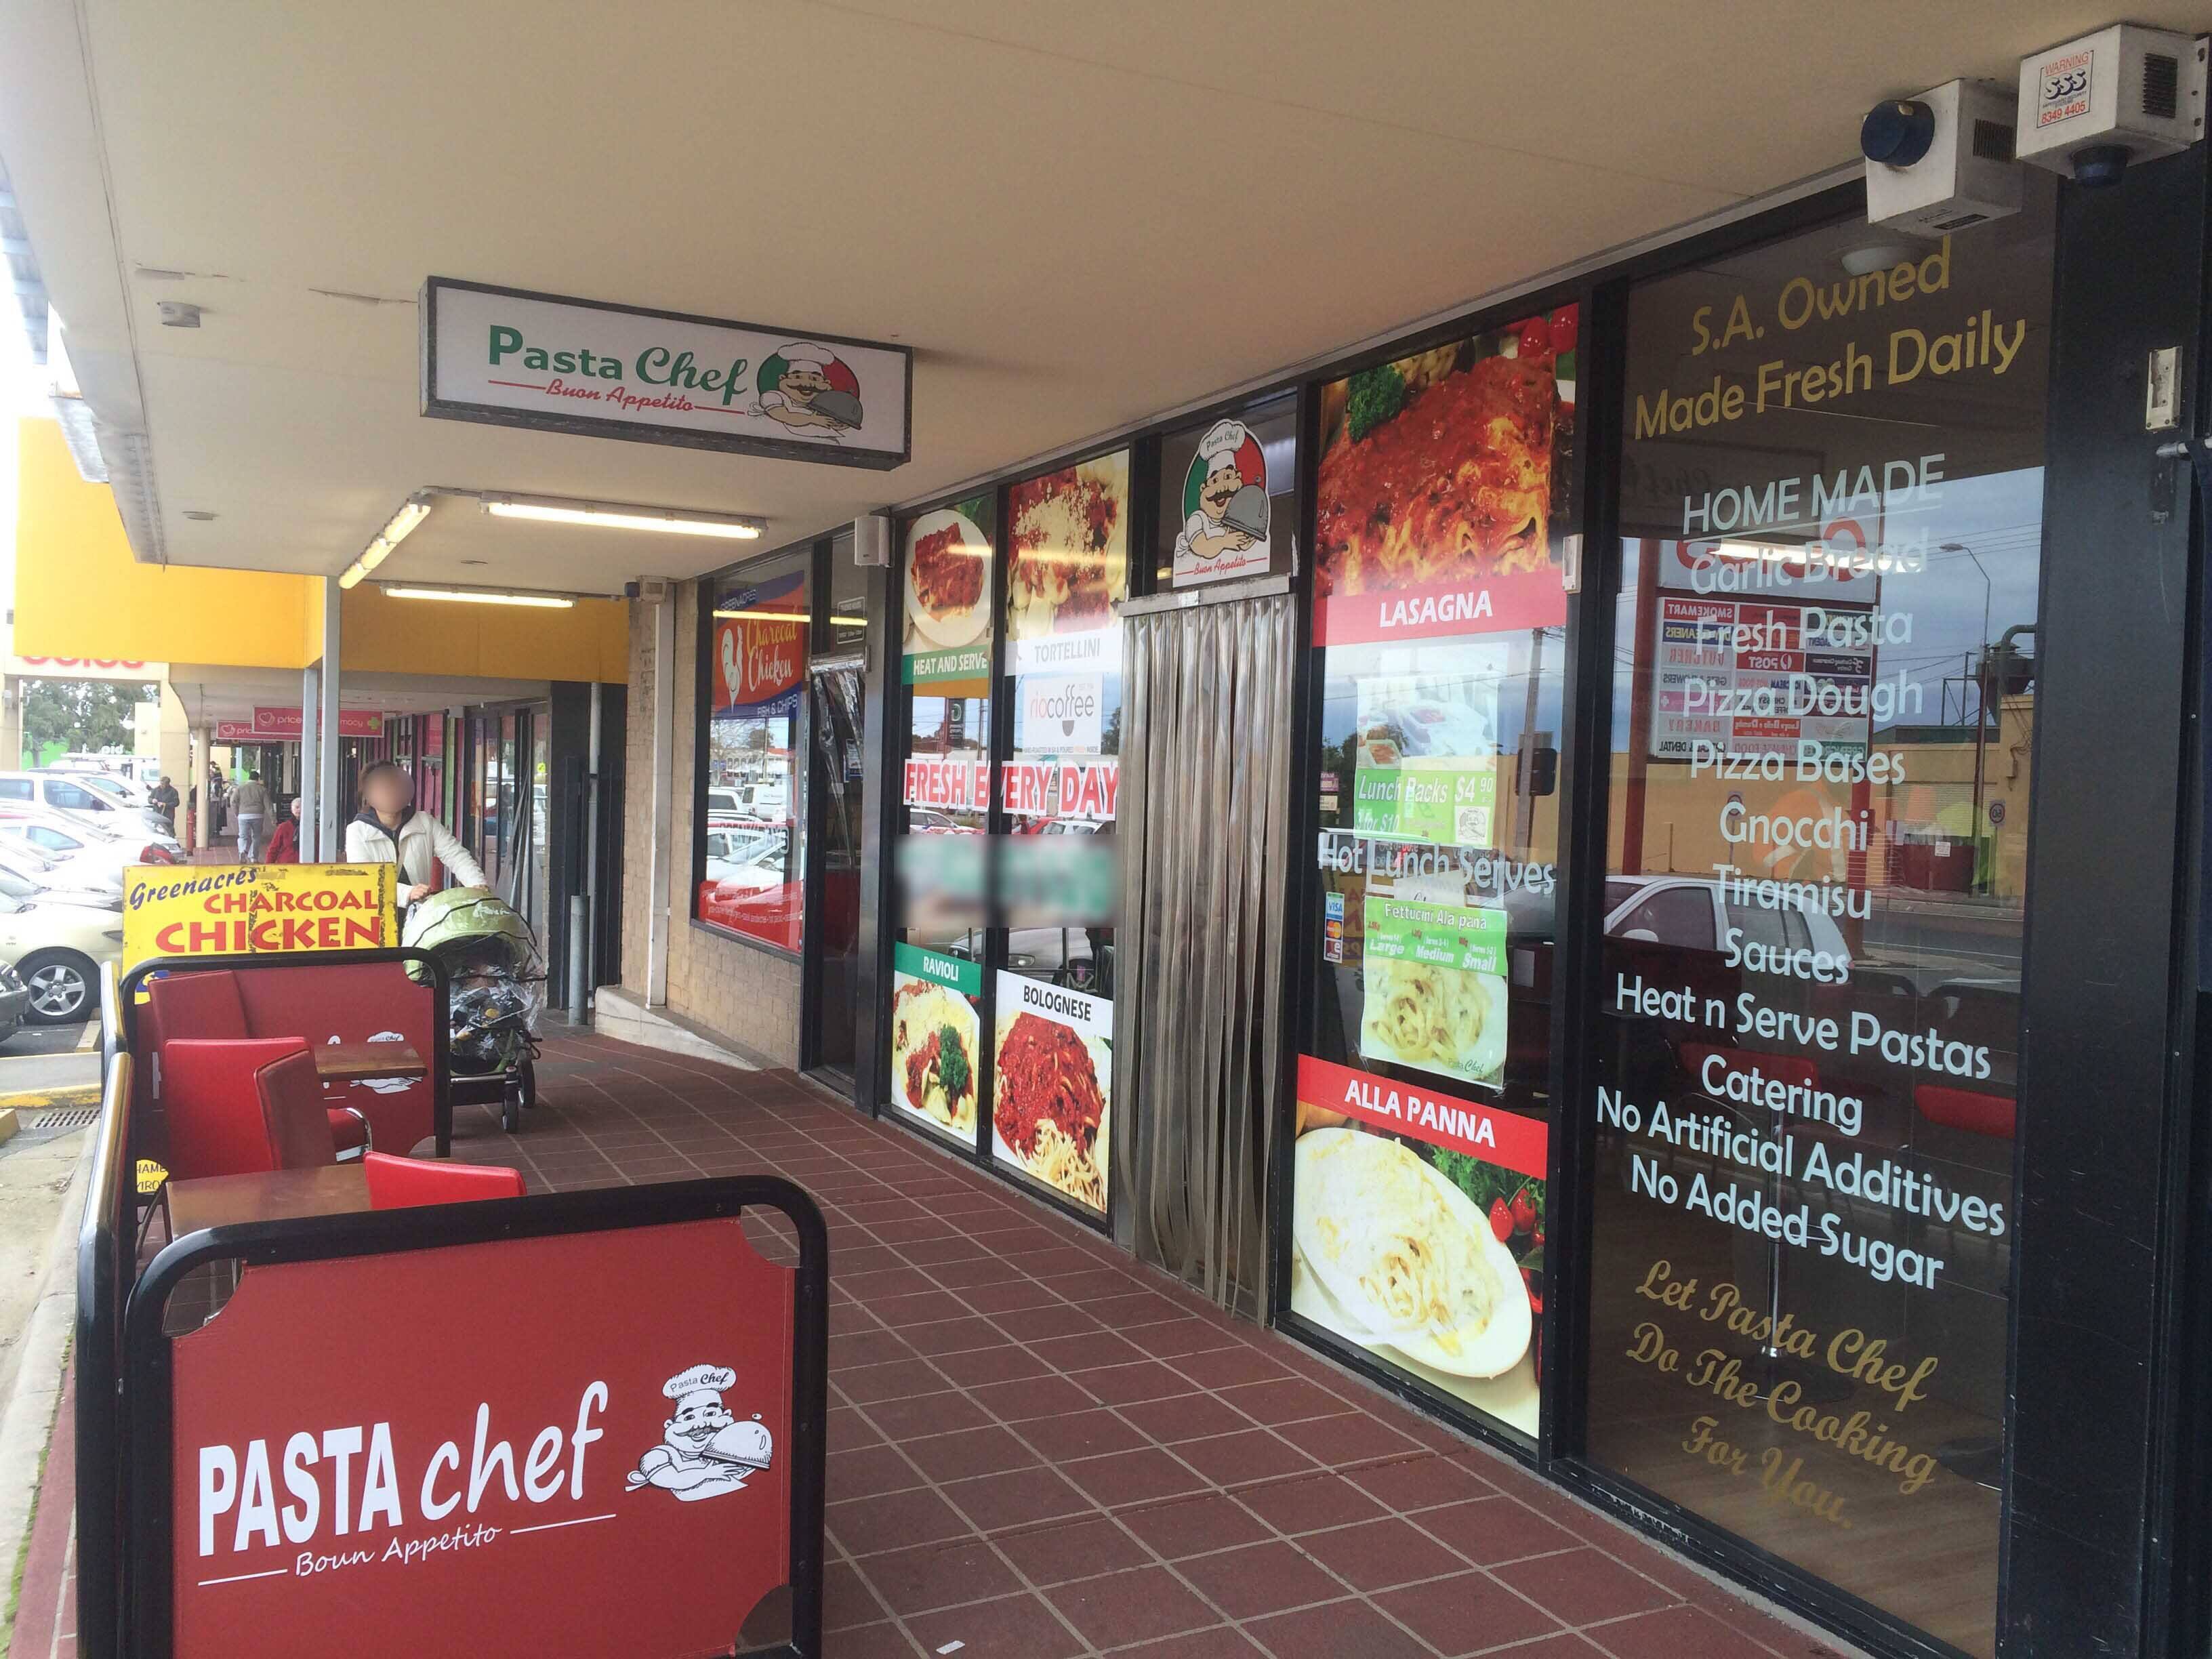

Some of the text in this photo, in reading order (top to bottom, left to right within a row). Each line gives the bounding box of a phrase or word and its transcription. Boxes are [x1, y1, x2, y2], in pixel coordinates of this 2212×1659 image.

[2043, 68, 2087, 100] SSS
[2045, 52, 2089, 75] WARNING
[2041, 108, 2062, 124] 8349
[2064, 100, 2086, 117] 4405
[1692, 234, 1952, 356] S.A. Owned
[488, 325, 749, 406] Pasta Chef
[1635, 309, 2026, 441] Made Fresh Daily
[546, 377, 694, 412] Buon Appetito
[1206, 430, 1239, 452] Pasta Chef
[1683, 453, 1946, 535] HOME MADE
[1193, 556, 1247, 575] Buon Appetito
[1691, 544, 1793, 595] Garlic
[1803, 527, 1929, 583] Bread
[1380, 590, 1493, 628] LASAGNA
[1696, 606, 1914, 655] Fresh Pasta
[748, 645, 794, 692] Chicken
[914, 653, 987, 676] HEAT AND SERVE
[1034, 638, 1101, 664] TORTELLINI
[777, 694, 798, 713] CHIPS
[1030, 684, 1094, 719] riocoffee
[1683, 678, 1786, 718] Pizza
[1788, 668, 1925, 722] Dough
[276, 716, 363, 728] price macy
[1690, 739, 1907, 785] Pizza Bases
[905, 762, 964, 808] FRESH
[1061, 766, 1119, 815] DAY
[1358, 775, 1401, 802] Lunch
[1454, 775, 1476, 803] $4
[1479, 777, 1493, 792] 90
[1720, 801, 1869, 851] Gnocchi
[1317, 832, 1363, 875] Hot
[1366, 838, 1450, 881] Lunch
[1457, 845, 1556, 895] Serves
[129, 867, 257, 910] Greenacres
[203, 890, 378, 914] CHARCOAL
[1328, 901, 1343, 913] VISA
[1713, 863, 1872, 920] Tiramisu
[155, 916, 381, 953] CHICKEN
[1385, 903, 1487, 933] Fettucini Ala pana
[923, 956, 959, 982] RAVIOLI
[1369, 938, 1497, 972] Large Medium Small
[1724, 926, 1849, 985] Sauces
[1023, 985, 1092, 1022] BOLOGNESE
[1616, 972, 1992, 1081] Heat n Serve Pastas
[1464, 1059, 1483, 1074] Chef
[1344, 1079, 1496, 1149] ALLA PANNA
[1701, 1053, 1864, 1136] Catering
[1595, 1086, 2006, 1237] No Artificial Additives
[1631, 1153, 1945, 1290] No Added Sugar
[1635, 1260, 1940, 1412] Let Pasta Chef
[670, 1371, 730, 1393] Pasta Chef
[1625, 1322, 1938, 1496] Do The Cooking
[197, 1380, 609, 1558] PASTA chef
[1681, 1416, 1748, 1476] For
[295, 1521, 503, 1578] Boun Appetito
